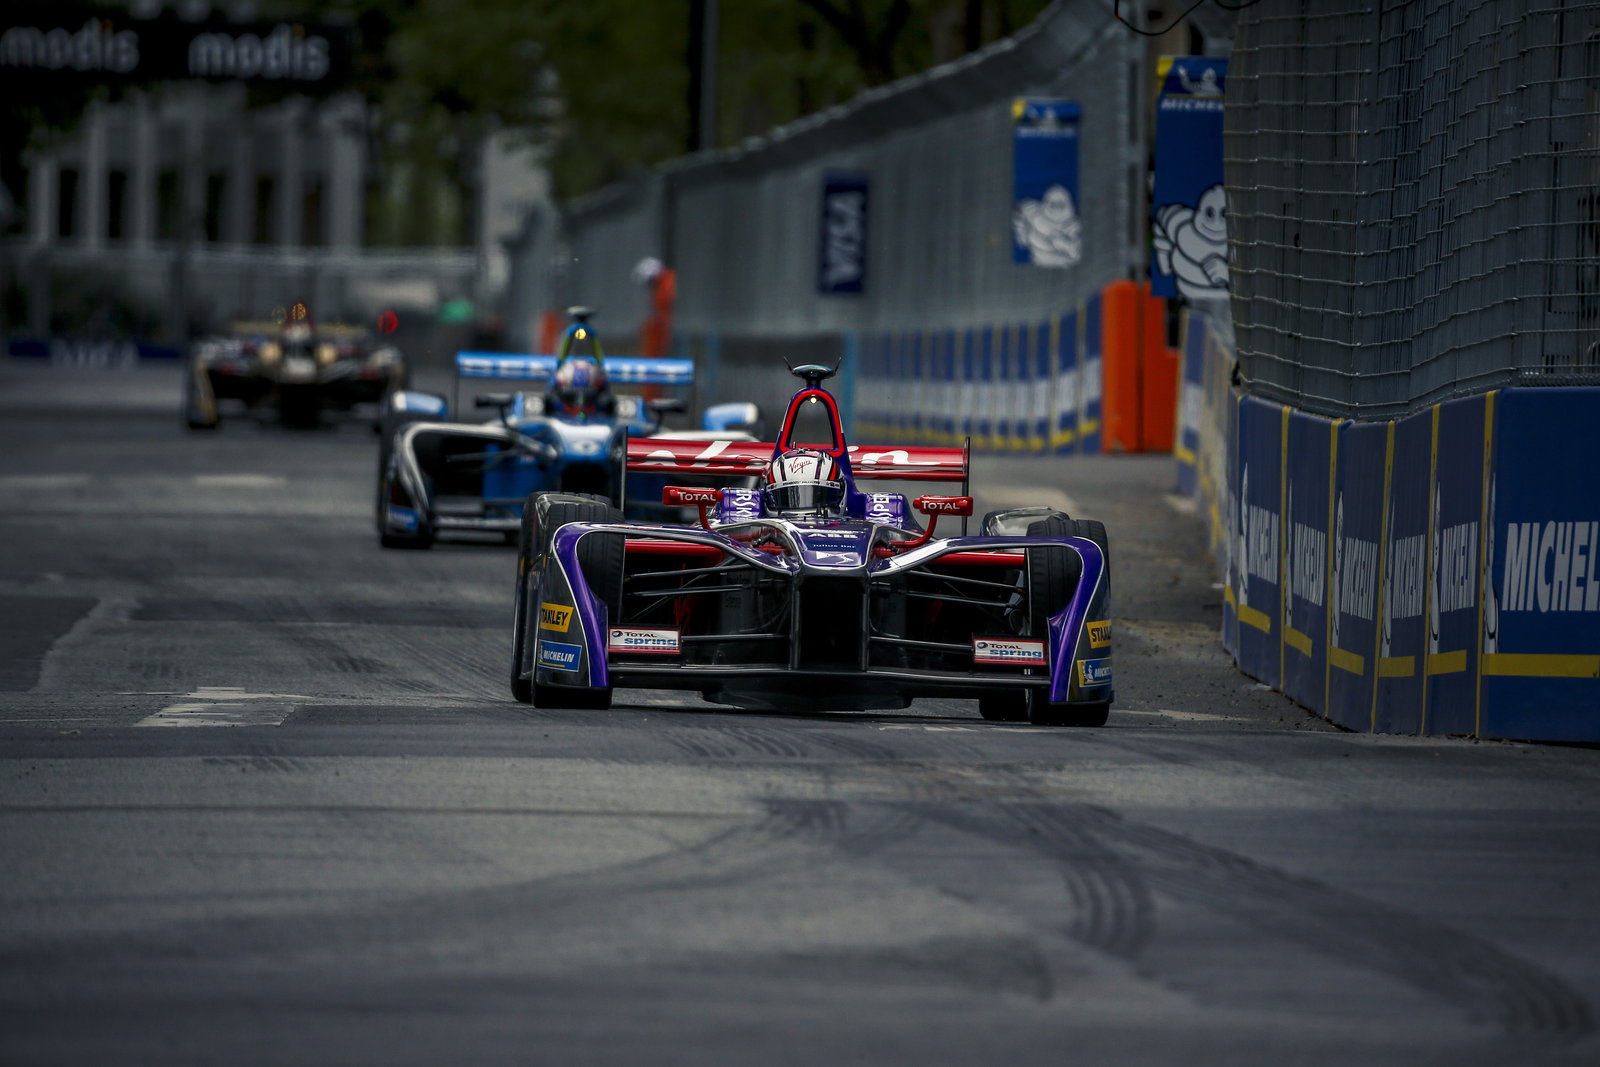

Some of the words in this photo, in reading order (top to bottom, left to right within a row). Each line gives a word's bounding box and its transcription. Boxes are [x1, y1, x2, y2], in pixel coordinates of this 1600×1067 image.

[188, 23, 329, 80] modis
[789, 457, 813, 473] Virgin
[677, 491, 716, 501] TOTAL
[921, 500, 960, 510] TOTAL
[1501, 520, 1600, 613] MICHEL
[624, 637, 677, 646] spring
[543, 649, 575, 662] MICHELIN
[989, 649, 1042, 658] spring
